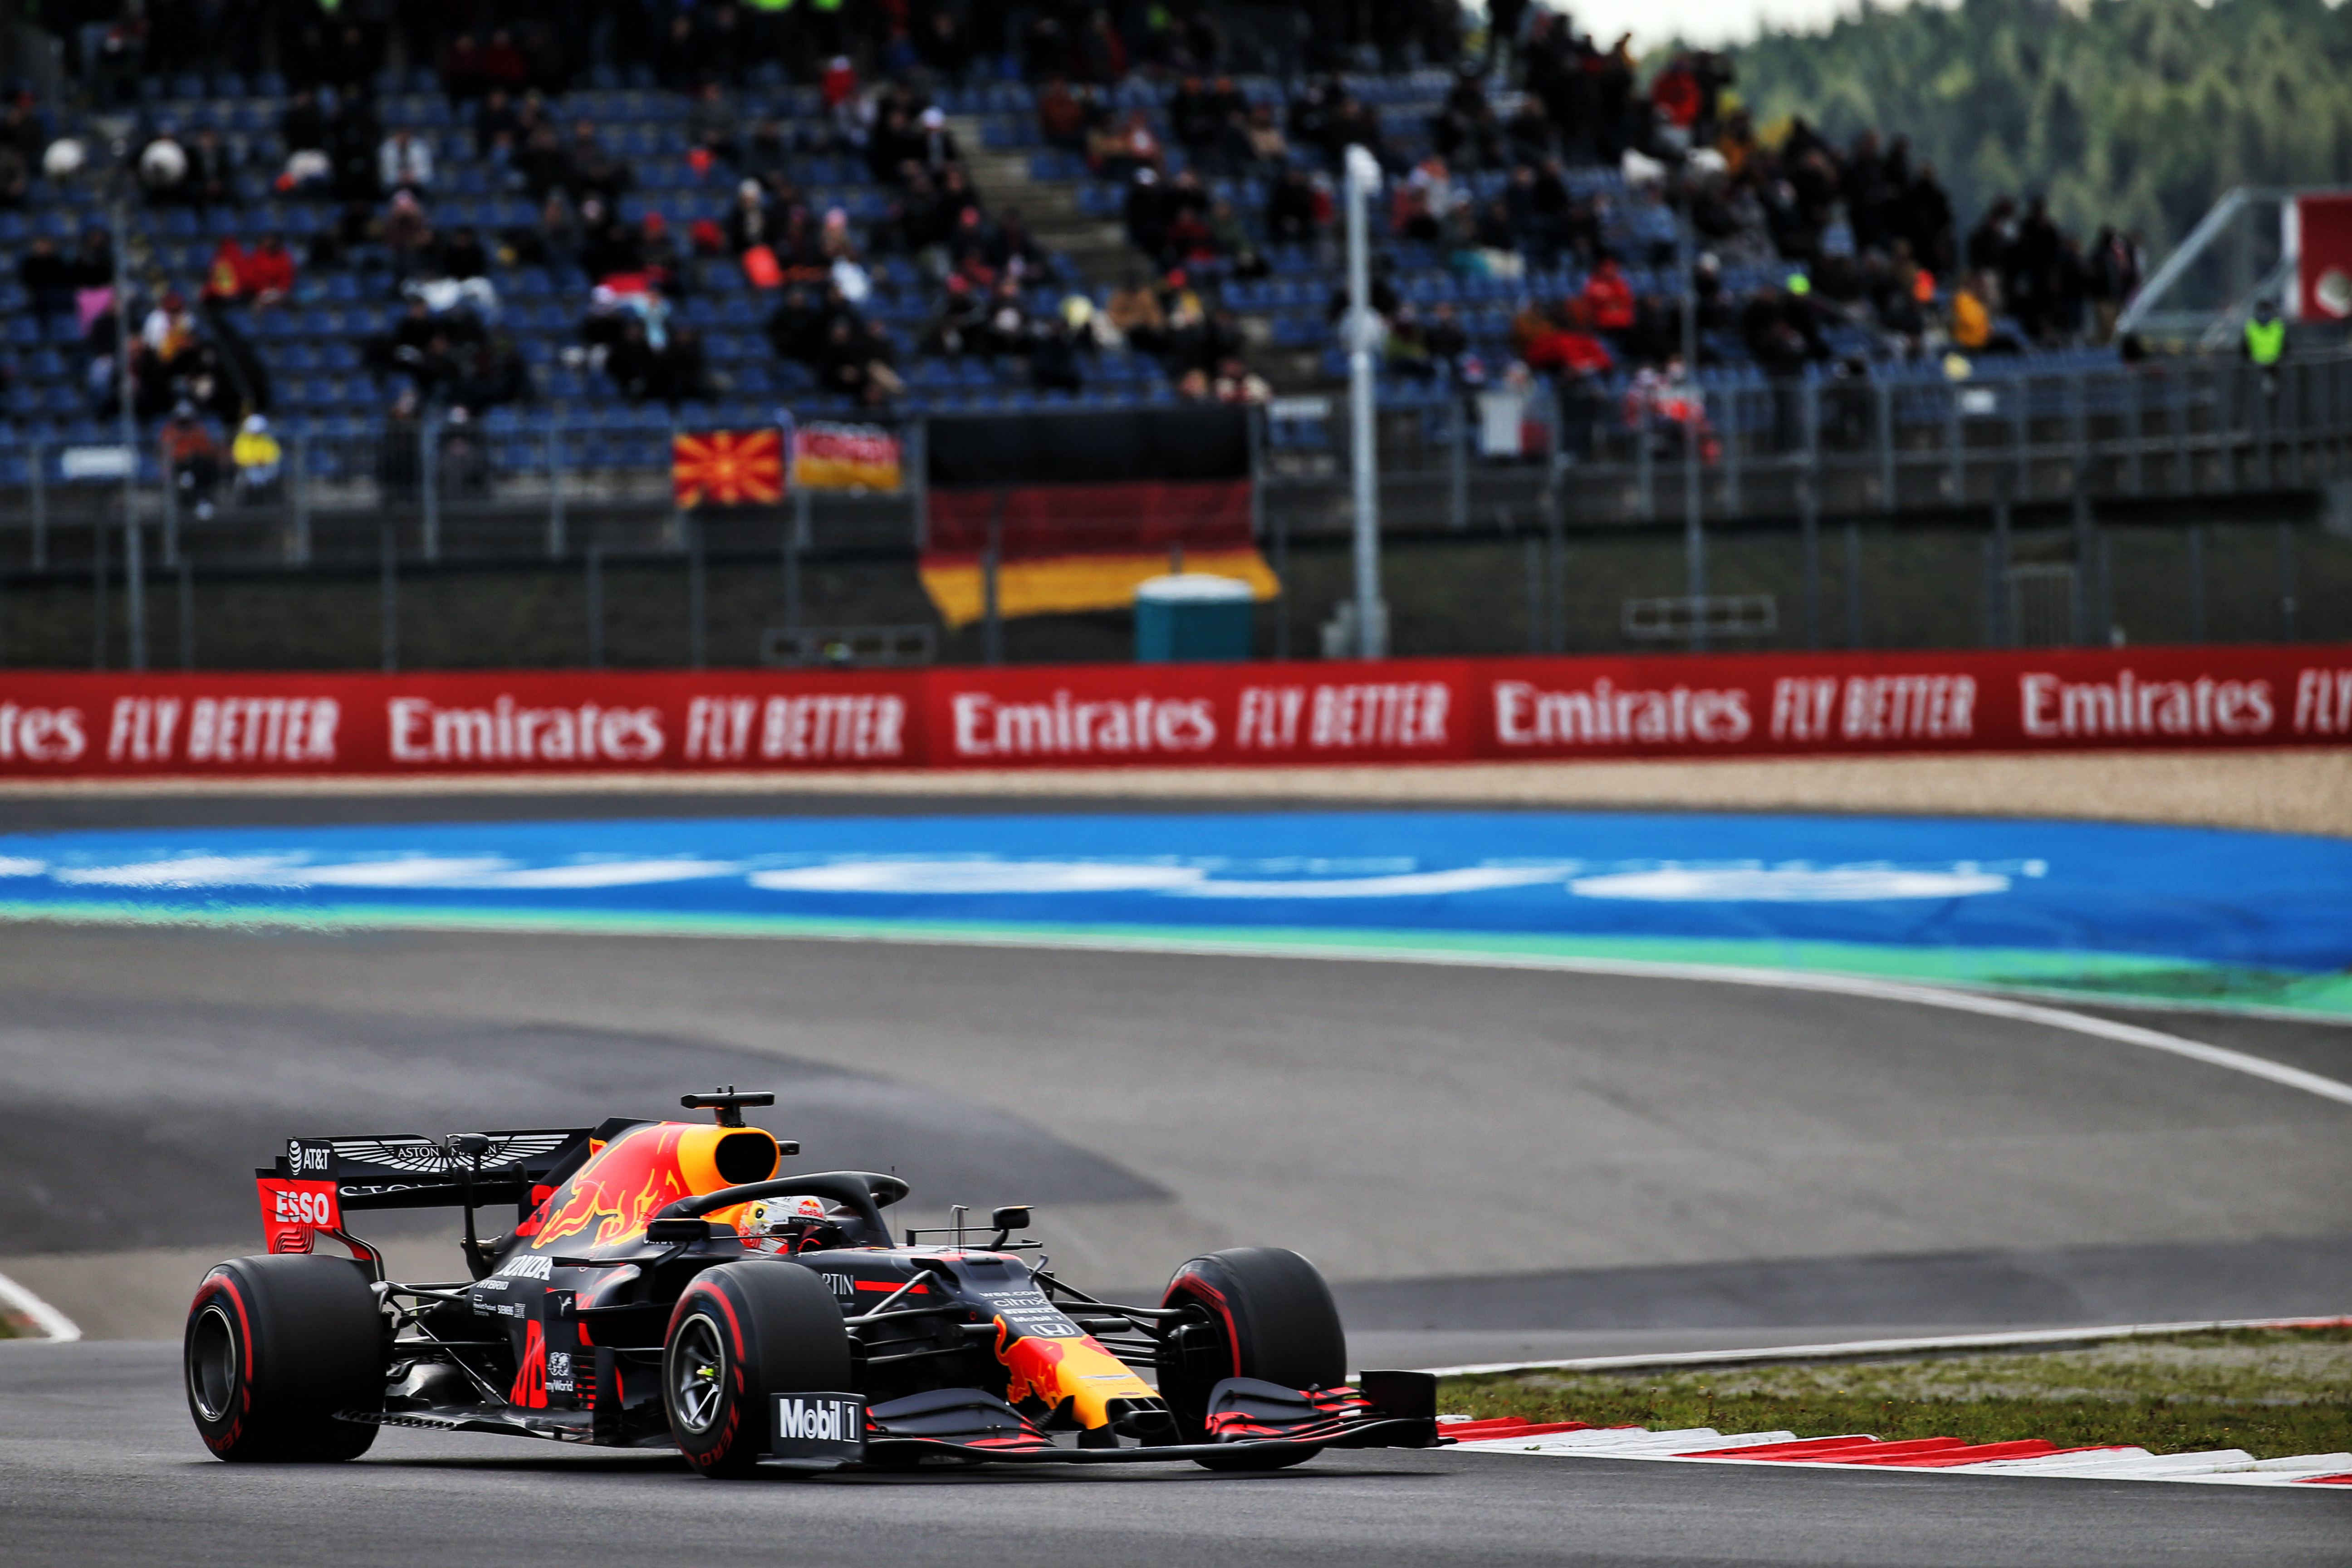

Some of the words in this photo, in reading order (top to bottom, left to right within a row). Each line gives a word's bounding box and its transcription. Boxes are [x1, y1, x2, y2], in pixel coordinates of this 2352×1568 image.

[951, 690, 1217, 755] Emirates
[1237, 686, 1304, 747] FLY
[1310, 682, 1450, 747] BETTER
[1493, 678, 1752, 745] Emirates
[1771, 677, 1837, 739] FLY
[1842, 675, 1976, 738] BETTER
[2019, 669, 2274, 737] Emirates
[0, 702, 86, 760] tes
[108, 696, 181, 760] FLY
[187, 696, 340, 760] BETTER
[387, 696, 665, 761] Emirates
[686, 696, 756, 759] FLY
[761, 695, 905, 758] BETTER
[303, 1149, 330, 1169] AT&T
[398, 1147, 439, 1157] ASTON
[276, 1191, 329, 1225] ESSO
[476, 1279, 510, 1290] HYBRID
[495, 1254, 553, 1281] ONDA
[822, 1273, 854, 1295] RTIN
[993, 1297, 1049, 1307] citrix
[779, 1398, 841, 1441] Mobil
[848, 1406, 855, 1438] 1
